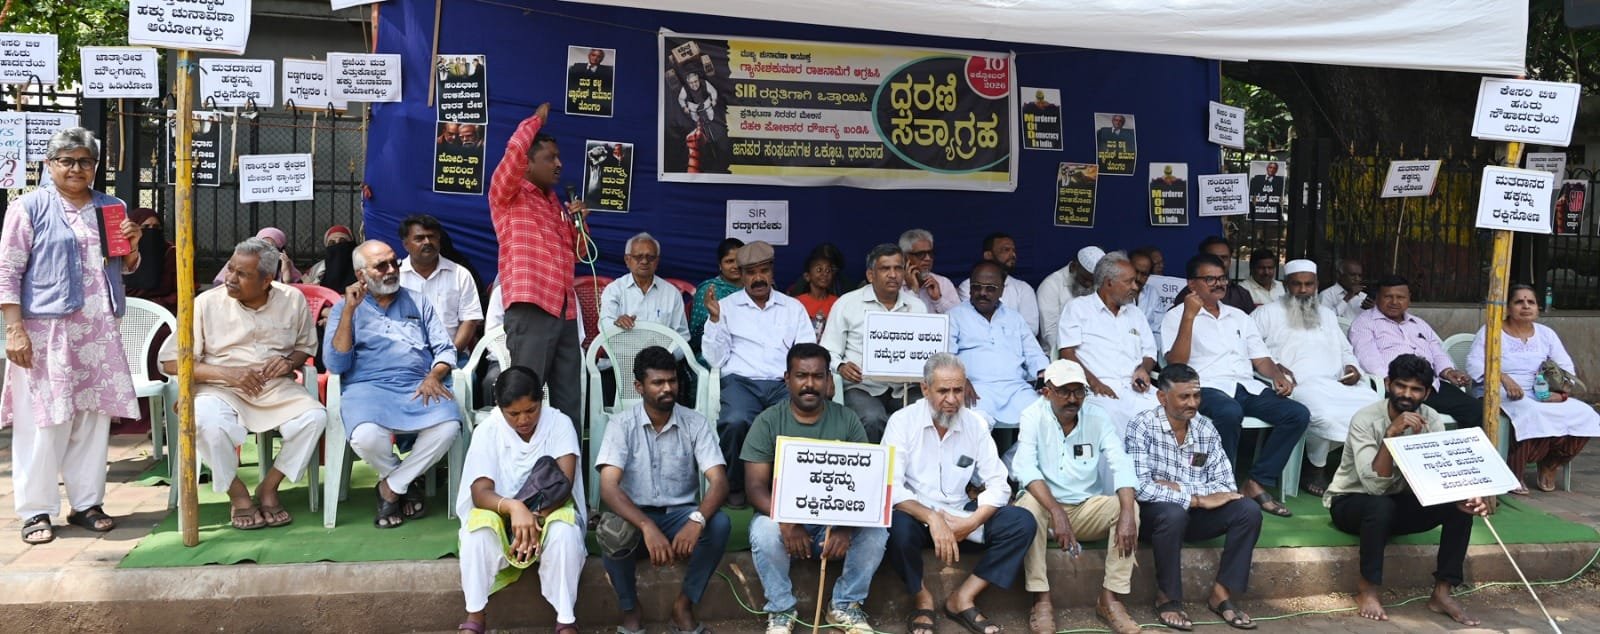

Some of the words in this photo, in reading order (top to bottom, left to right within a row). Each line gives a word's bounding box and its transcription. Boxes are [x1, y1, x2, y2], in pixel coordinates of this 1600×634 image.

[137, 5, 165, 22] ಹಕ್ಕು
[172, 8, 235, 22] ಚುನಾವಣಾ
[147, 21, 224, 42] ಆಯೋಗಕ್ಕಿಲ್ಲ
[1, 39, 20, 47] ಸರಿ
[4, 49, 30, 57] ಹಸಿರು
[740, 50, 756, 62] ಮುಖ್ಯ
[760, 51, 788, 59] ಚುನಾವಣಾ
[790, 52, 811, 63] ಆಯುಕ್ತ
[96, 54, 142, 65] ಜಾತ್ಯಾತೀತ
[984, 57, 1004, 70] 10
[94, 66, 146, 79] ಮೌಲ್ಯಗಳನ್ನು
[212, 64, 262, 72] ಮತದಾನದ
[740, 62, 802, 78] ಗ್ಯಾನೇಶಕುಮಾರ
[854, 67, 880, 80] ಆಗ್ರಹಿಸಿ
[89, 82, 104, 92] ಎತ್ತಿ
[109, 81, 153, 90] ಹಿಡಿಯೋಣ
[221, 75, 253, 87] ಹಕ್ಕನ್ನು
[336, 78, 353, 88] ಹಕ್ಕು
[214, 89, 260, 101] ರಕ್ಷಿಸೋಣ
[343, 87, 387, 98] ಆಯೋಗಕ್ಕಿಲ್ಲ
[442, 90, 481, 99] ಉಳಿಸೋಣ
[735, 83, 757, 98] SIR
[817, 91, 868, 105] ಒತ್ತಾಯಿಸಿ
[890, 73, 957, 115] ಧರಣಿ
[1500, 85, 1533, 97] ಕೇಸರಿ
[1538, 90, 1558, 99] ಬಿಳಿ
[441, 102, 464, 110] ಭಾರತ
[467, 100, 483, 108] ದೇಶ
[1510, 99, 1542, 110] ಹಸಿರು
[445, 111, 480, 122] ರಕ್ಷಿಸೋಣ
[774, 110, 797, 118] ನಿರತರ
[799, 110, 822, 119] ಮೇಲಿನ
[1023, 113, 1057, 123] Murderer
[1489, 108, 1559, 124] ಸೌಹಾರ್ದತೆಯ
[740, 120, 761, 130] ದೆಹಲಿ
[807, 122, 840, 139] ದೌರ್ಜನ್ಯ
[843, 125, 869, 134] ಖಂಡಿಸಿ
[1504, 123, 1541, 134] ಉಸಿರು
[891, 111, 998, 160] ಸತ್ಯಾಗ್ರಹ
[1027, 130, 1059, 141] Democracy
[732, 140, 760, 156] ಜನಪರ
[764, 140, 811, 159] ಸಂಘಟನೆಗಳ
[847, 144, 884, 161] ಧಾರವಾಡ
[245, 162, 280, 173] ಸಾಂಸ್ಕೃತಿಕ
[284, 161, 306, 171] ಕ್ಷೇತ್ರದ
[442, 166, 474, 174] ಅವರಿಂದ
[1397, 164, 1430, 172] ಮತದಾನದ
[437, 174, 455, 184] ದೇಶ
[458, 177, 478, 189] ರಕ್ಷಿಸಿ
[1207, 178, 1239, 186] ಸಂವಿಧಾನ
[1401, 173, 1421, 183] ಹಕ್ಕನ್ನು
[1495, 175, 1545, 189] ಮತದಾನದ
[1151, 189, 1184, 198] Murderer
[1393, 184, 1423, 193] ರಕ್ಷಿಸೋಣ
[1503, 191, 1534, 207] ಹಕ್ಕನ್ನು
[1569, 191, 1584, 212] SIR
[748, 208, 767, 218] SIR
[1154, 206, 1185, 215] Democracy
[1492, 208, 1540, 224] ರಕ್ಷಿಸೋಣ
[732, 221, 782, 234] ರದ್ದಾಗಬೇಕು
[1161, 283, 1179, 293] SIR
[869, 329, 914, 342] ಸಂವಿಧಾನದ
[918, 331, 942, 342] ಆಶಯ
[874, 347, 906, 364] ನಮ್ಮೆಲ್ಲರ
[1403, 441, 1440, 451] ಚುನಾವಣಾ
[797, 449, 871, 467] ಮತದಾನದ
[1455, 455, 1485, 466] ಕುಮಾರ
[809, 469, 855, 492] ಹಕ್ಕನ್ನು
[796, 494, 866, 517] ರಕ್ಷಿಸೋಣ
